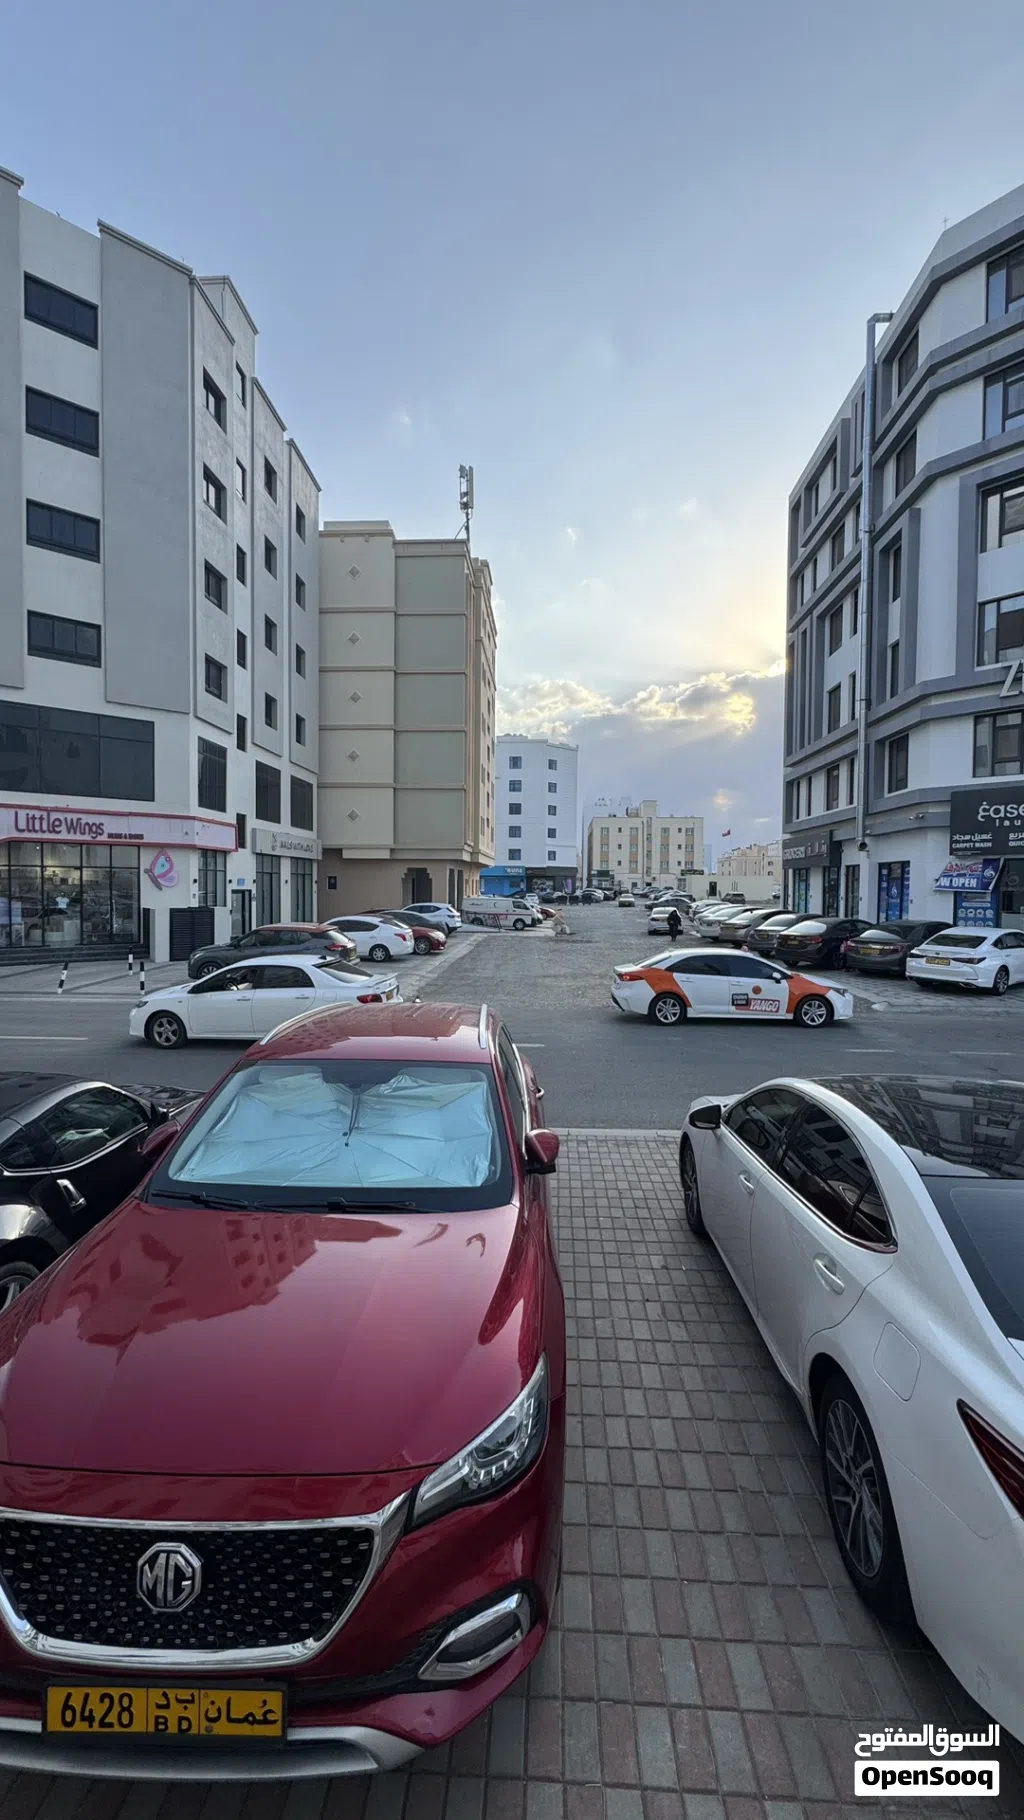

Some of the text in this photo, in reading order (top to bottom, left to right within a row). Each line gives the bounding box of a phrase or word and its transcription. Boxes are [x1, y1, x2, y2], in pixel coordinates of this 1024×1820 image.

[14, 810, 104, 839] Little Wings
[971, 832, 993, 842] غسيل
[952, 877, 977, 888] OPEN
[749, 999, 779, 1012] YANGO
[141, 1552, 194, 1607] MG
[60, 1691, 134, 1729] 6428
